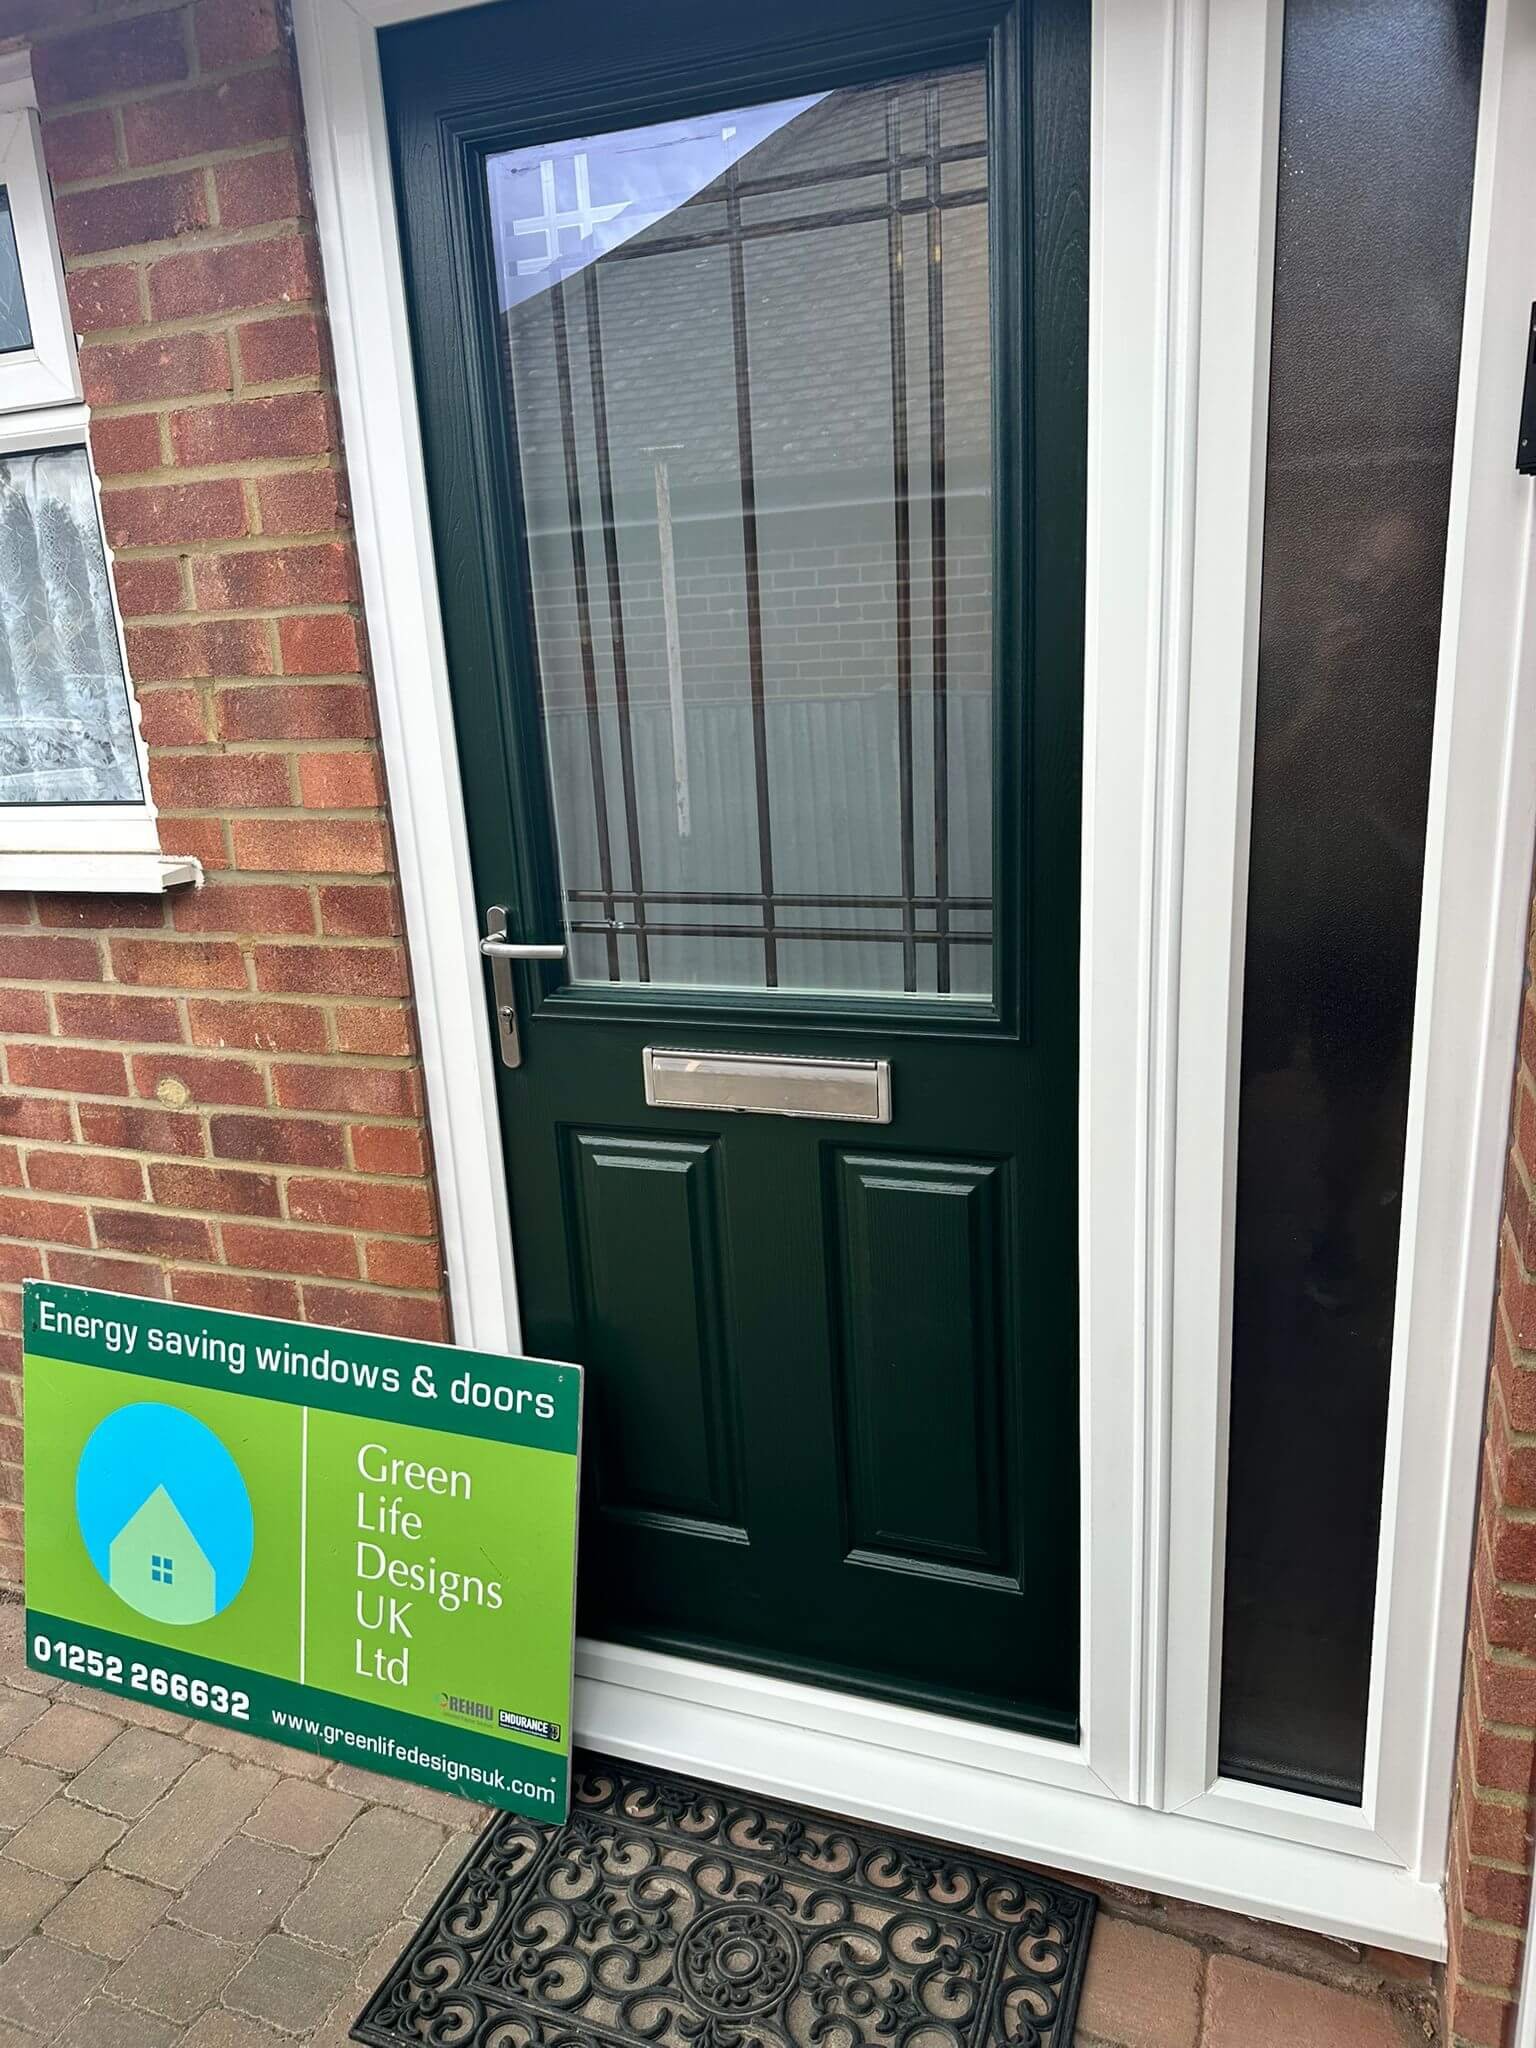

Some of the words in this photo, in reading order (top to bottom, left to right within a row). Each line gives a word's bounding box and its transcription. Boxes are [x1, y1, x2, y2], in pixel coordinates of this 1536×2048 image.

[39, 1301, 139, 1356] Energy
[147, 1328, 246, 1374] saving
[255, 1343, 401, 1393] windows
[411, 1365, 438, 1399] &
[450, 1371, 555, 1419] doors
[356, 1442, 472, 1500] Green
[356, 1491, 423, 1541] Life
[355, 1541, 503, 1612] Designs
[355, 1590, 413, 1639] UK
[33, 1635, 123, 1684] 01252
[130, 1664, 251, 1721] 266632
[355, 1639, 410, 1687] Ltd
[449, 1695, 494, 1721] REHAU
[499, 1711, 549, 1734] ENDURANCE
[271, 1707, 556, 1804] www.greenlifedesignsuk.com
